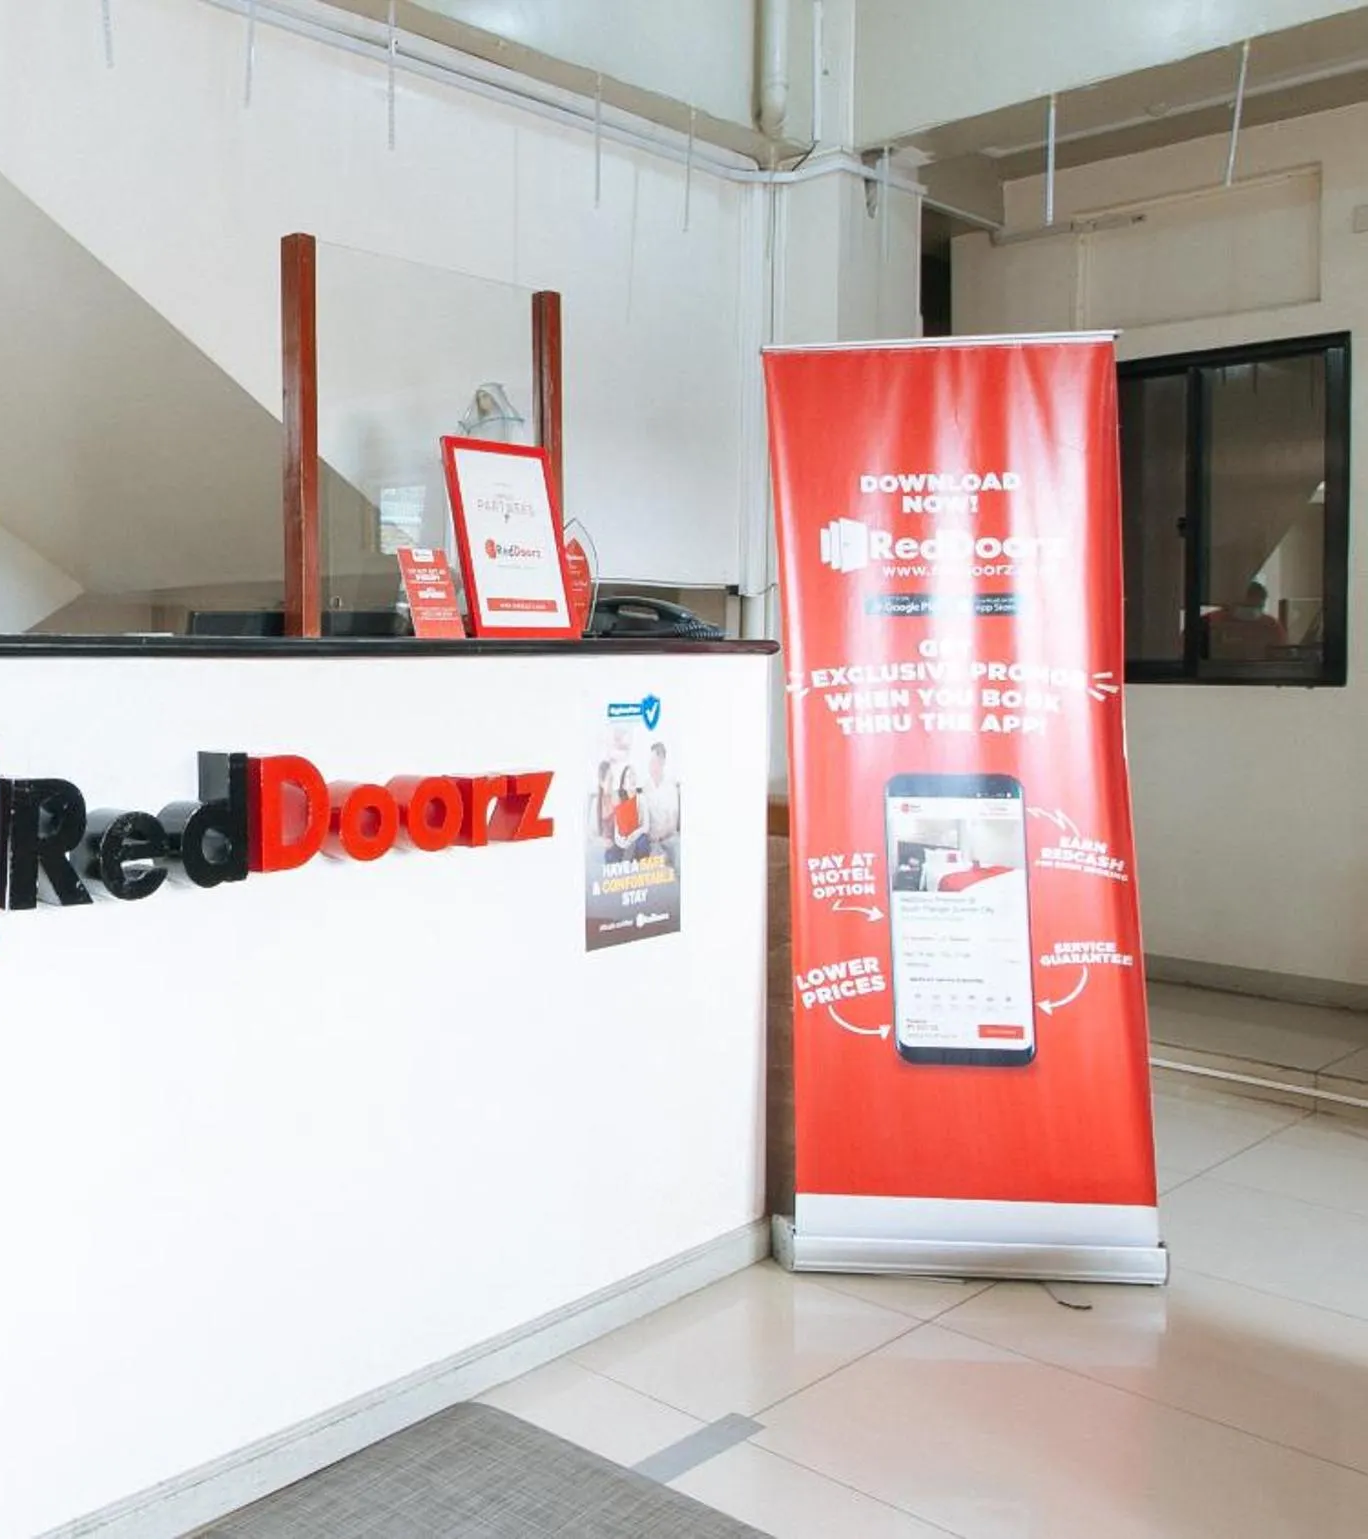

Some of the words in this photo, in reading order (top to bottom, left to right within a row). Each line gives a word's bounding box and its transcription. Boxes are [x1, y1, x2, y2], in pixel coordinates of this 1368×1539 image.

[860, 472, 1021, 493] DOWNLOAD
[902, 495, 978, 513] NOW!
[811, 662, 965, 688] EXCLUSIVE
[824, 689, 909, 712] WHEN
[917, 688, 973, 708] YOU
[981, 689, 1060, 712] BOOK
[837, 714, 912, 735] THRU
[919, 713, 973, 732] THE
[980, 714, 1047, 735] APP!
[807, 855, 845, 871] PAY
[851, 853, 876, 867] AT
[811, 867, 876, 886] HOTEL
[813, 883, 876, 899] OPTION
[796, 957, 880, 990] LOWER
[802, 975, 886, 1009] PRICES
